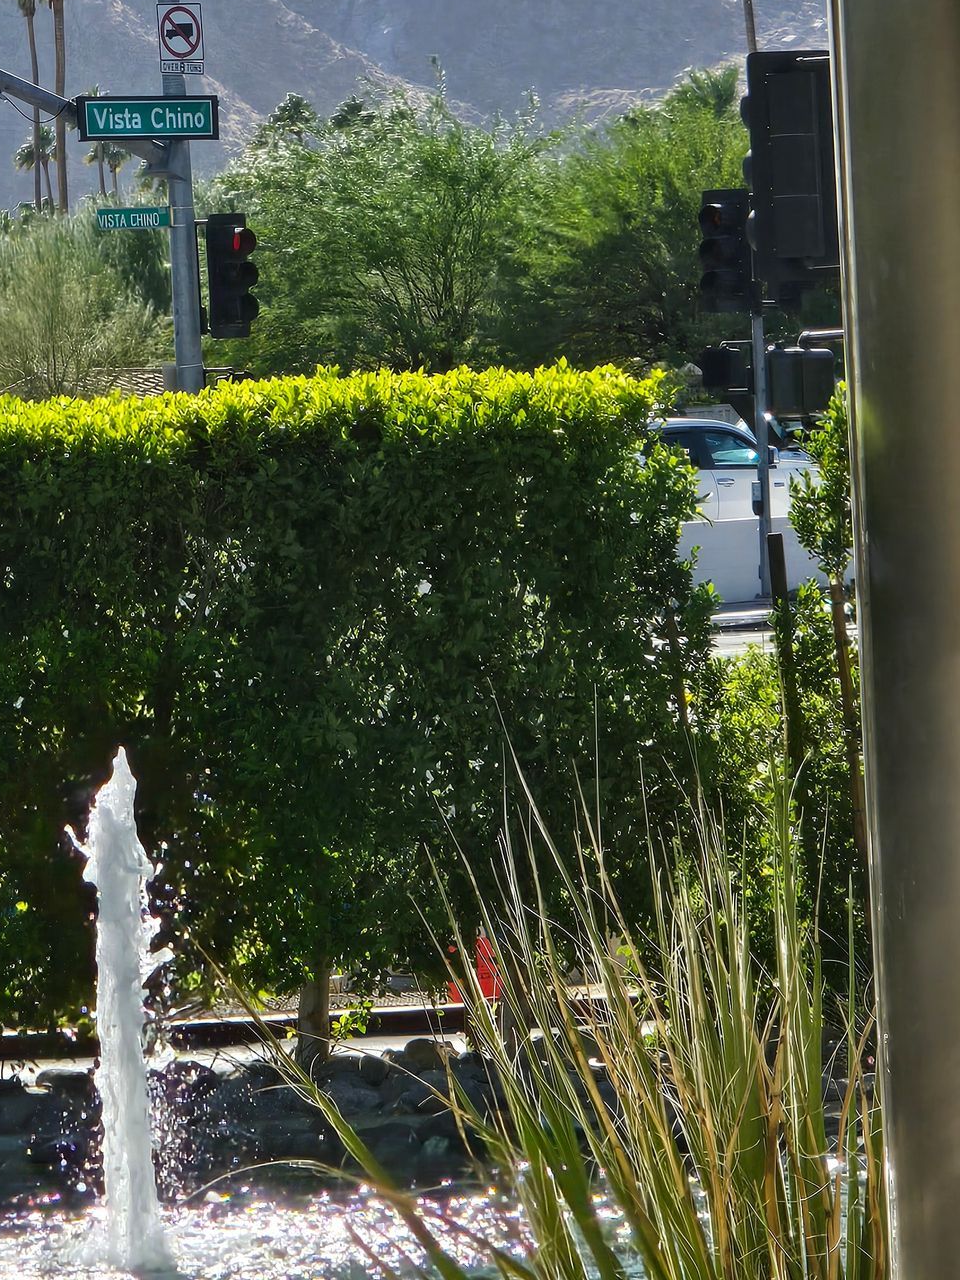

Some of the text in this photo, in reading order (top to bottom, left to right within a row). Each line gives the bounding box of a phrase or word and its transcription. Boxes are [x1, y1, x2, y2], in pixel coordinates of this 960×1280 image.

[93, 107, 205, 129] Vista Chino
[98, 212, 160, 228] VISTA CHINO
